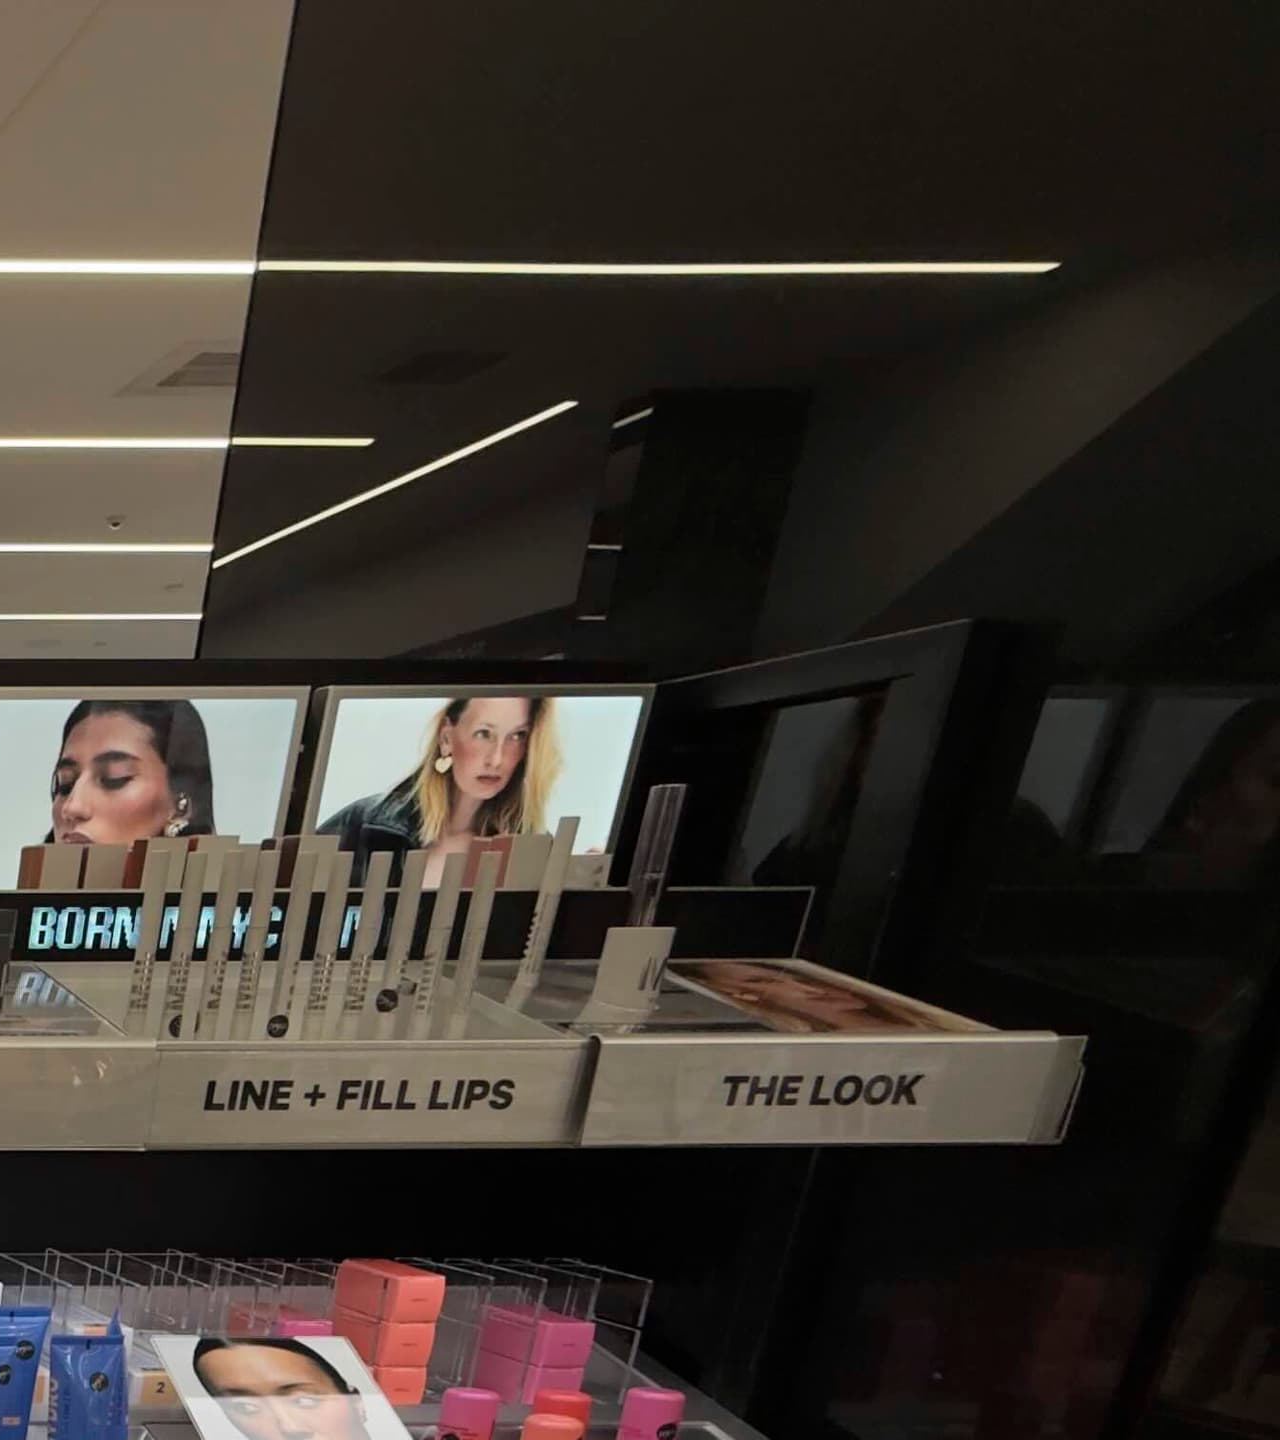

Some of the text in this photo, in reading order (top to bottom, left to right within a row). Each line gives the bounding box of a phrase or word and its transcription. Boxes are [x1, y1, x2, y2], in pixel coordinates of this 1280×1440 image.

[203, 1079, 516, 1111] LINE + FILL LIPS
[723, 1073, 925, 1107] THE LOOK
